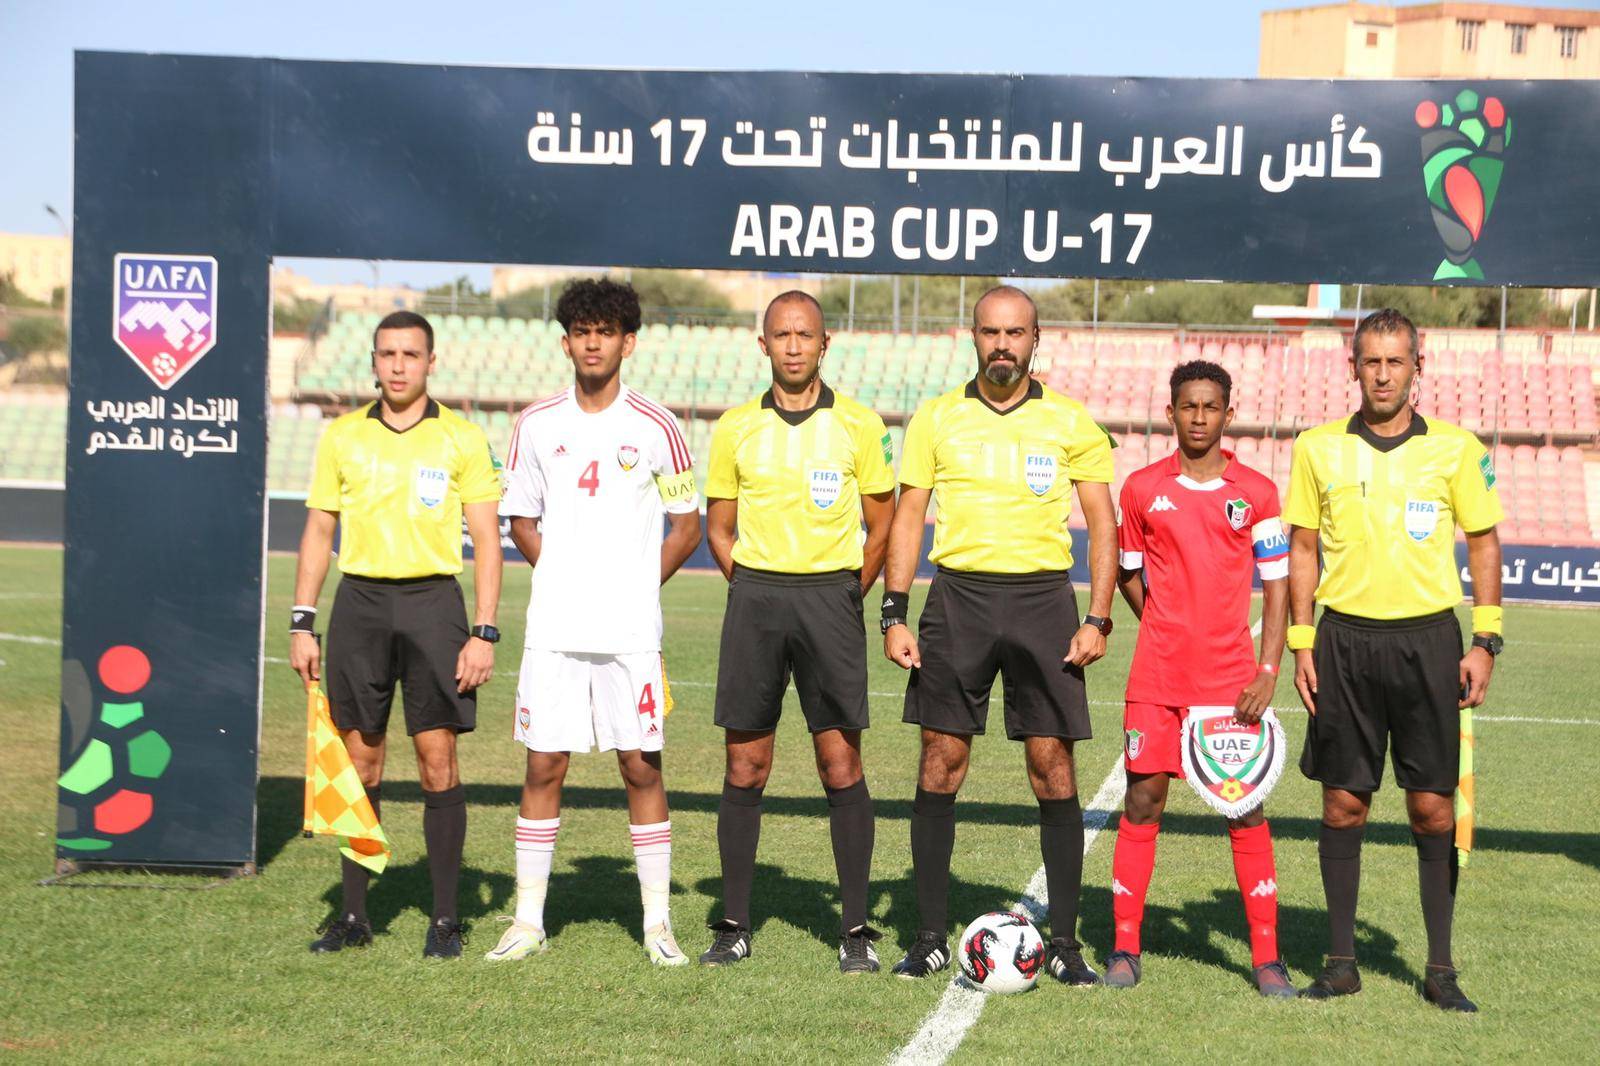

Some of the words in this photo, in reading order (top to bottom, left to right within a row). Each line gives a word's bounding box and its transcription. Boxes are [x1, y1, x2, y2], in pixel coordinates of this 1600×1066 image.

[527, 112, 634, 166] سنة
[650, 118, 707, 167] 17
[722, 116, 827, 168] تحت
[839, 117, 1083, 184] للمنتخبات
[1260, 113, 1383, 193] كأس
[1099, 125, 1244, 190] العرب
[730, 204, 875, 259] ARAB
[891, 207, 999, 261] CUP
[1022, 209, 1153, 265] U-17
[124, 263, 207, 291] UAFA
[86, 395, 166, 426] العربي
[85, 426, 165, 456] القدم
[169, 428, 238, 458] لكرة
[420, 469, 445, 481] FIFA
[813, 471, 838, 481] FIFA
[1027, 456, 1053, 466] FIFA
[577, 460, 600, 497] 4
[1408, 502, 1434, 513] FIFA
[638, 683, 656, 719] 4
[1213, 739, 1251, 751] UAE
[1222, 753, 1242, 763] FA
